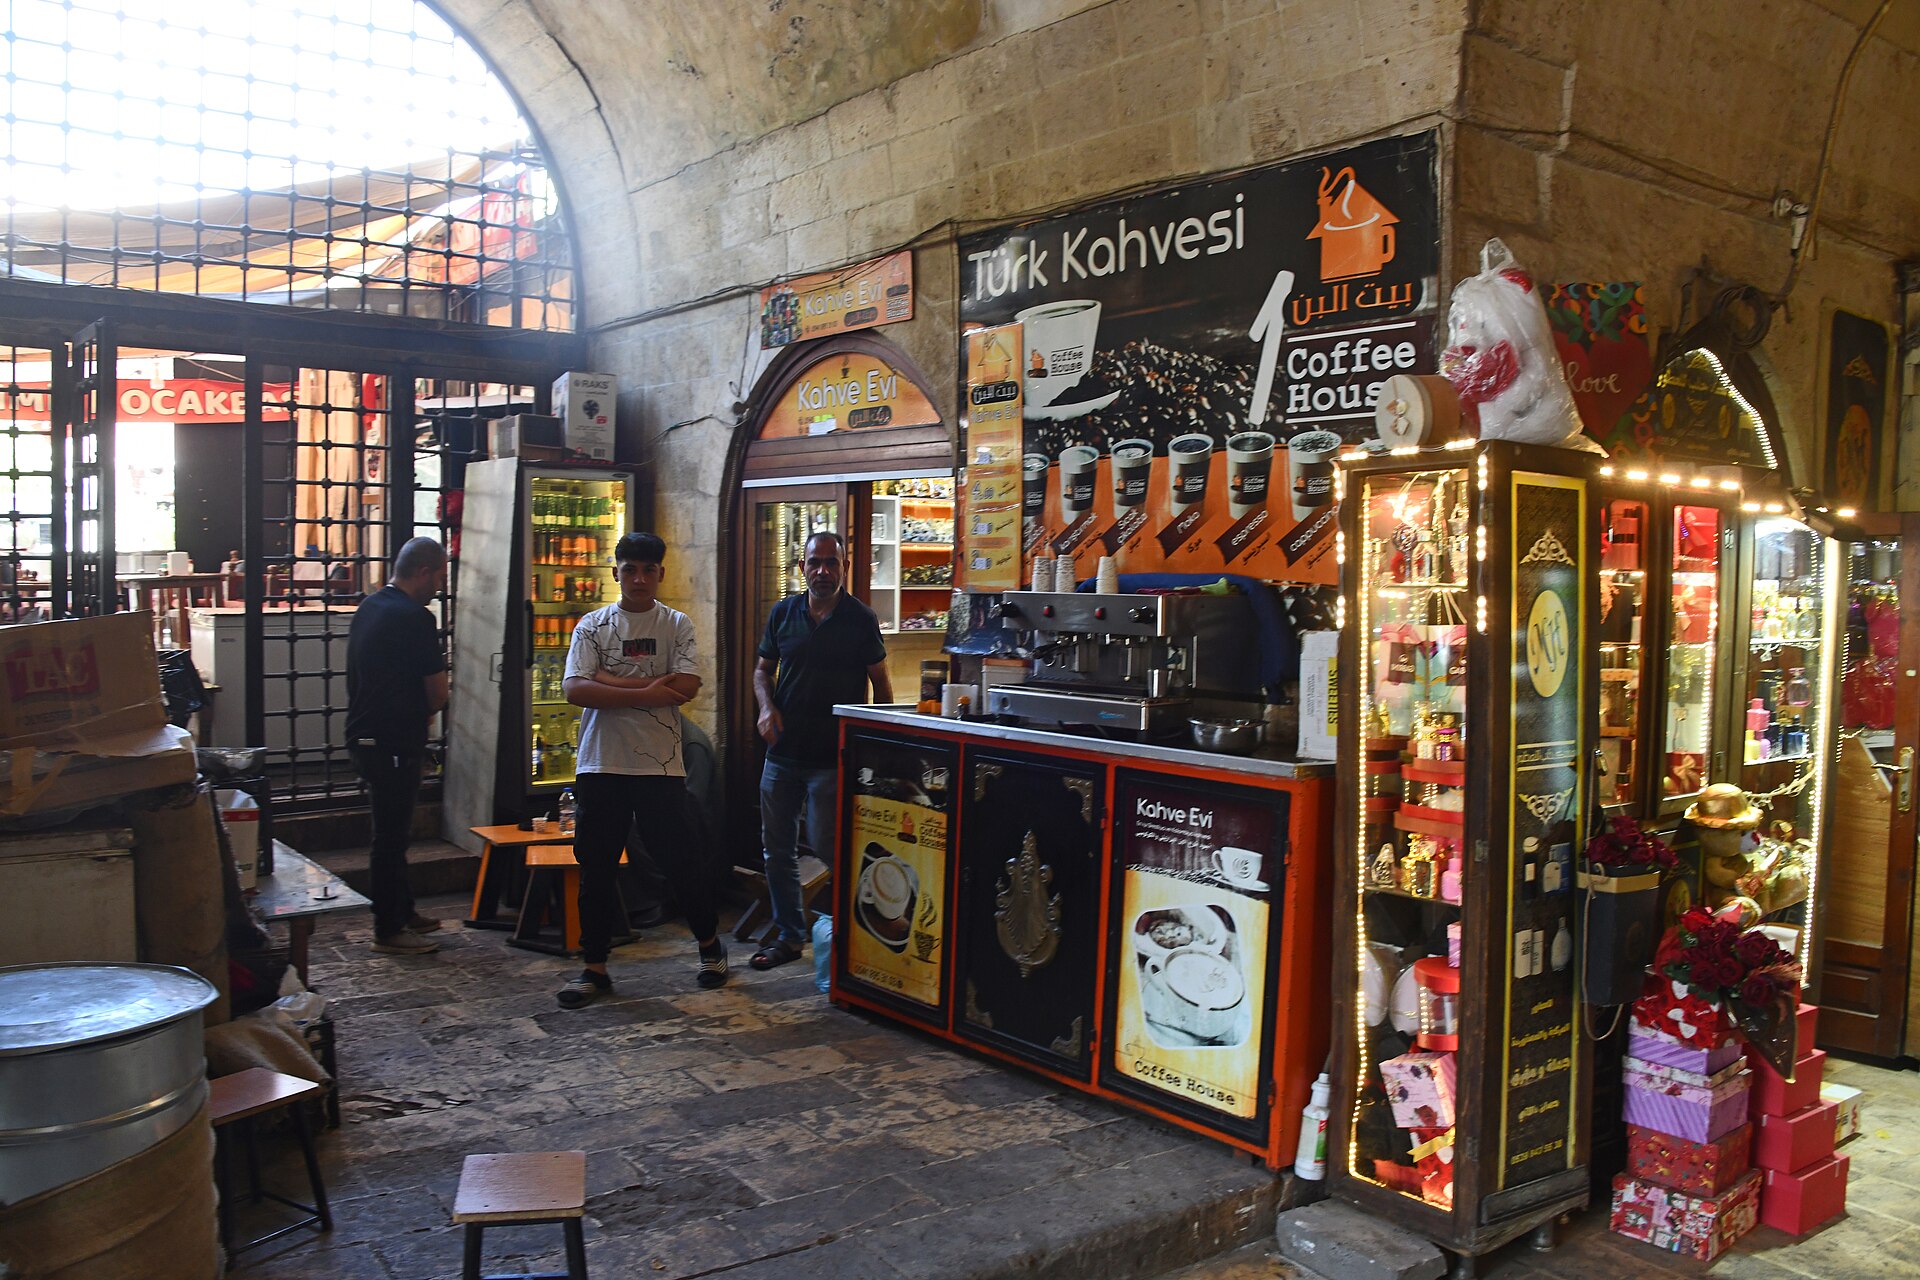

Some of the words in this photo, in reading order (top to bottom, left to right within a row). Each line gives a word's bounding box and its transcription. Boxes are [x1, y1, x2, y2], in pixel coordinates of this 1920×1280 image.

[967, 238, 1048, 300] Türk
[1062, 193, 1244, 283] Kahvesi
[804, 288, 854, 318] Kahve
[857, 276, 883, 306] Evi
[1292, 284, 1349, 326] البن
[1355, 283, 1413, 310] بيت
[1050, 350, 1083, 362] Coffee
[1050, 361, 1082, 374] House
[1287, 338, 1416, 380] Coffee
[797, 377, 861, 411] Kahve
[867, 367, 897, 402] Evi
[1566, 361, 1622, 394] love
[1286, 381, 1384, 414] Hous
[1231, 510, 1268, 545] espresso
[1136, 797, 1187, 824] Kahve
[1189, 806, 1213, 829] Evi
[1134, 1060, 1182, 1087] Coffee
[1186, 1078, 1236, 1106] House
